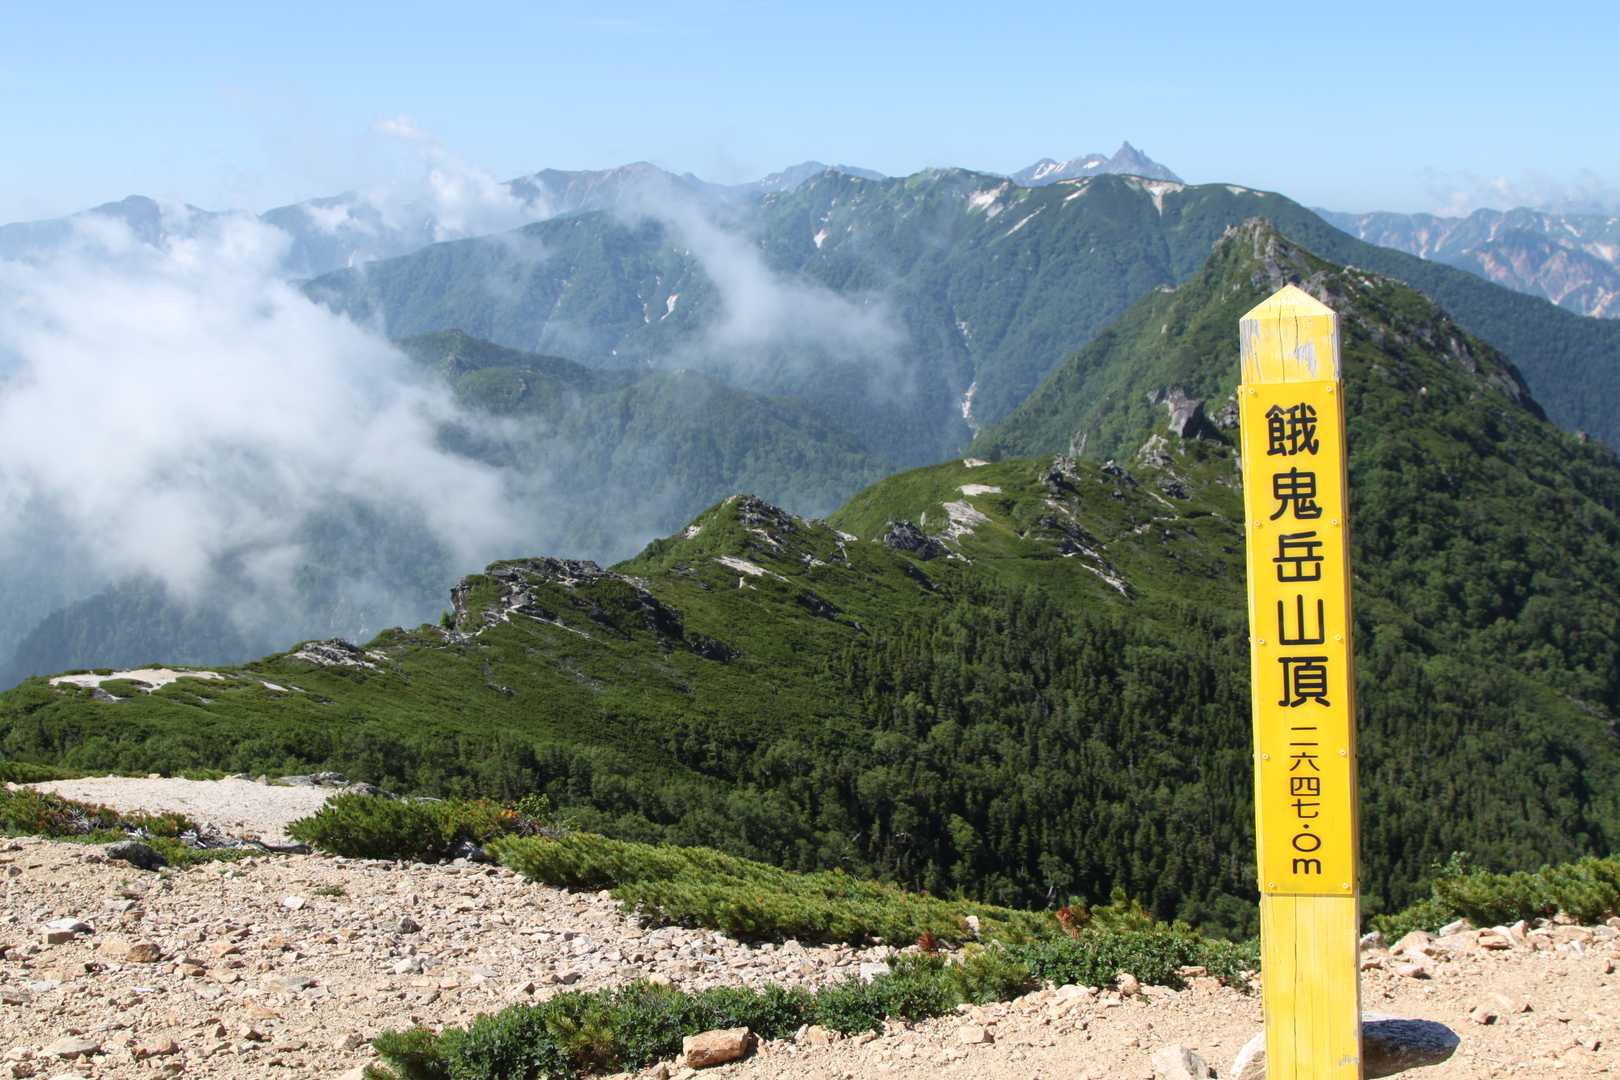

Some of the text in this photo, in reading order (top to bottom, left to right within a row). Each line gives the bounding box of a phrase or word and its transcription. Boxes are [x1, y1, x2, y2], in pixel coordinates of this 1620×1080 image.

[1265, 402, 1330, 708] 餓鬼岳山頂
